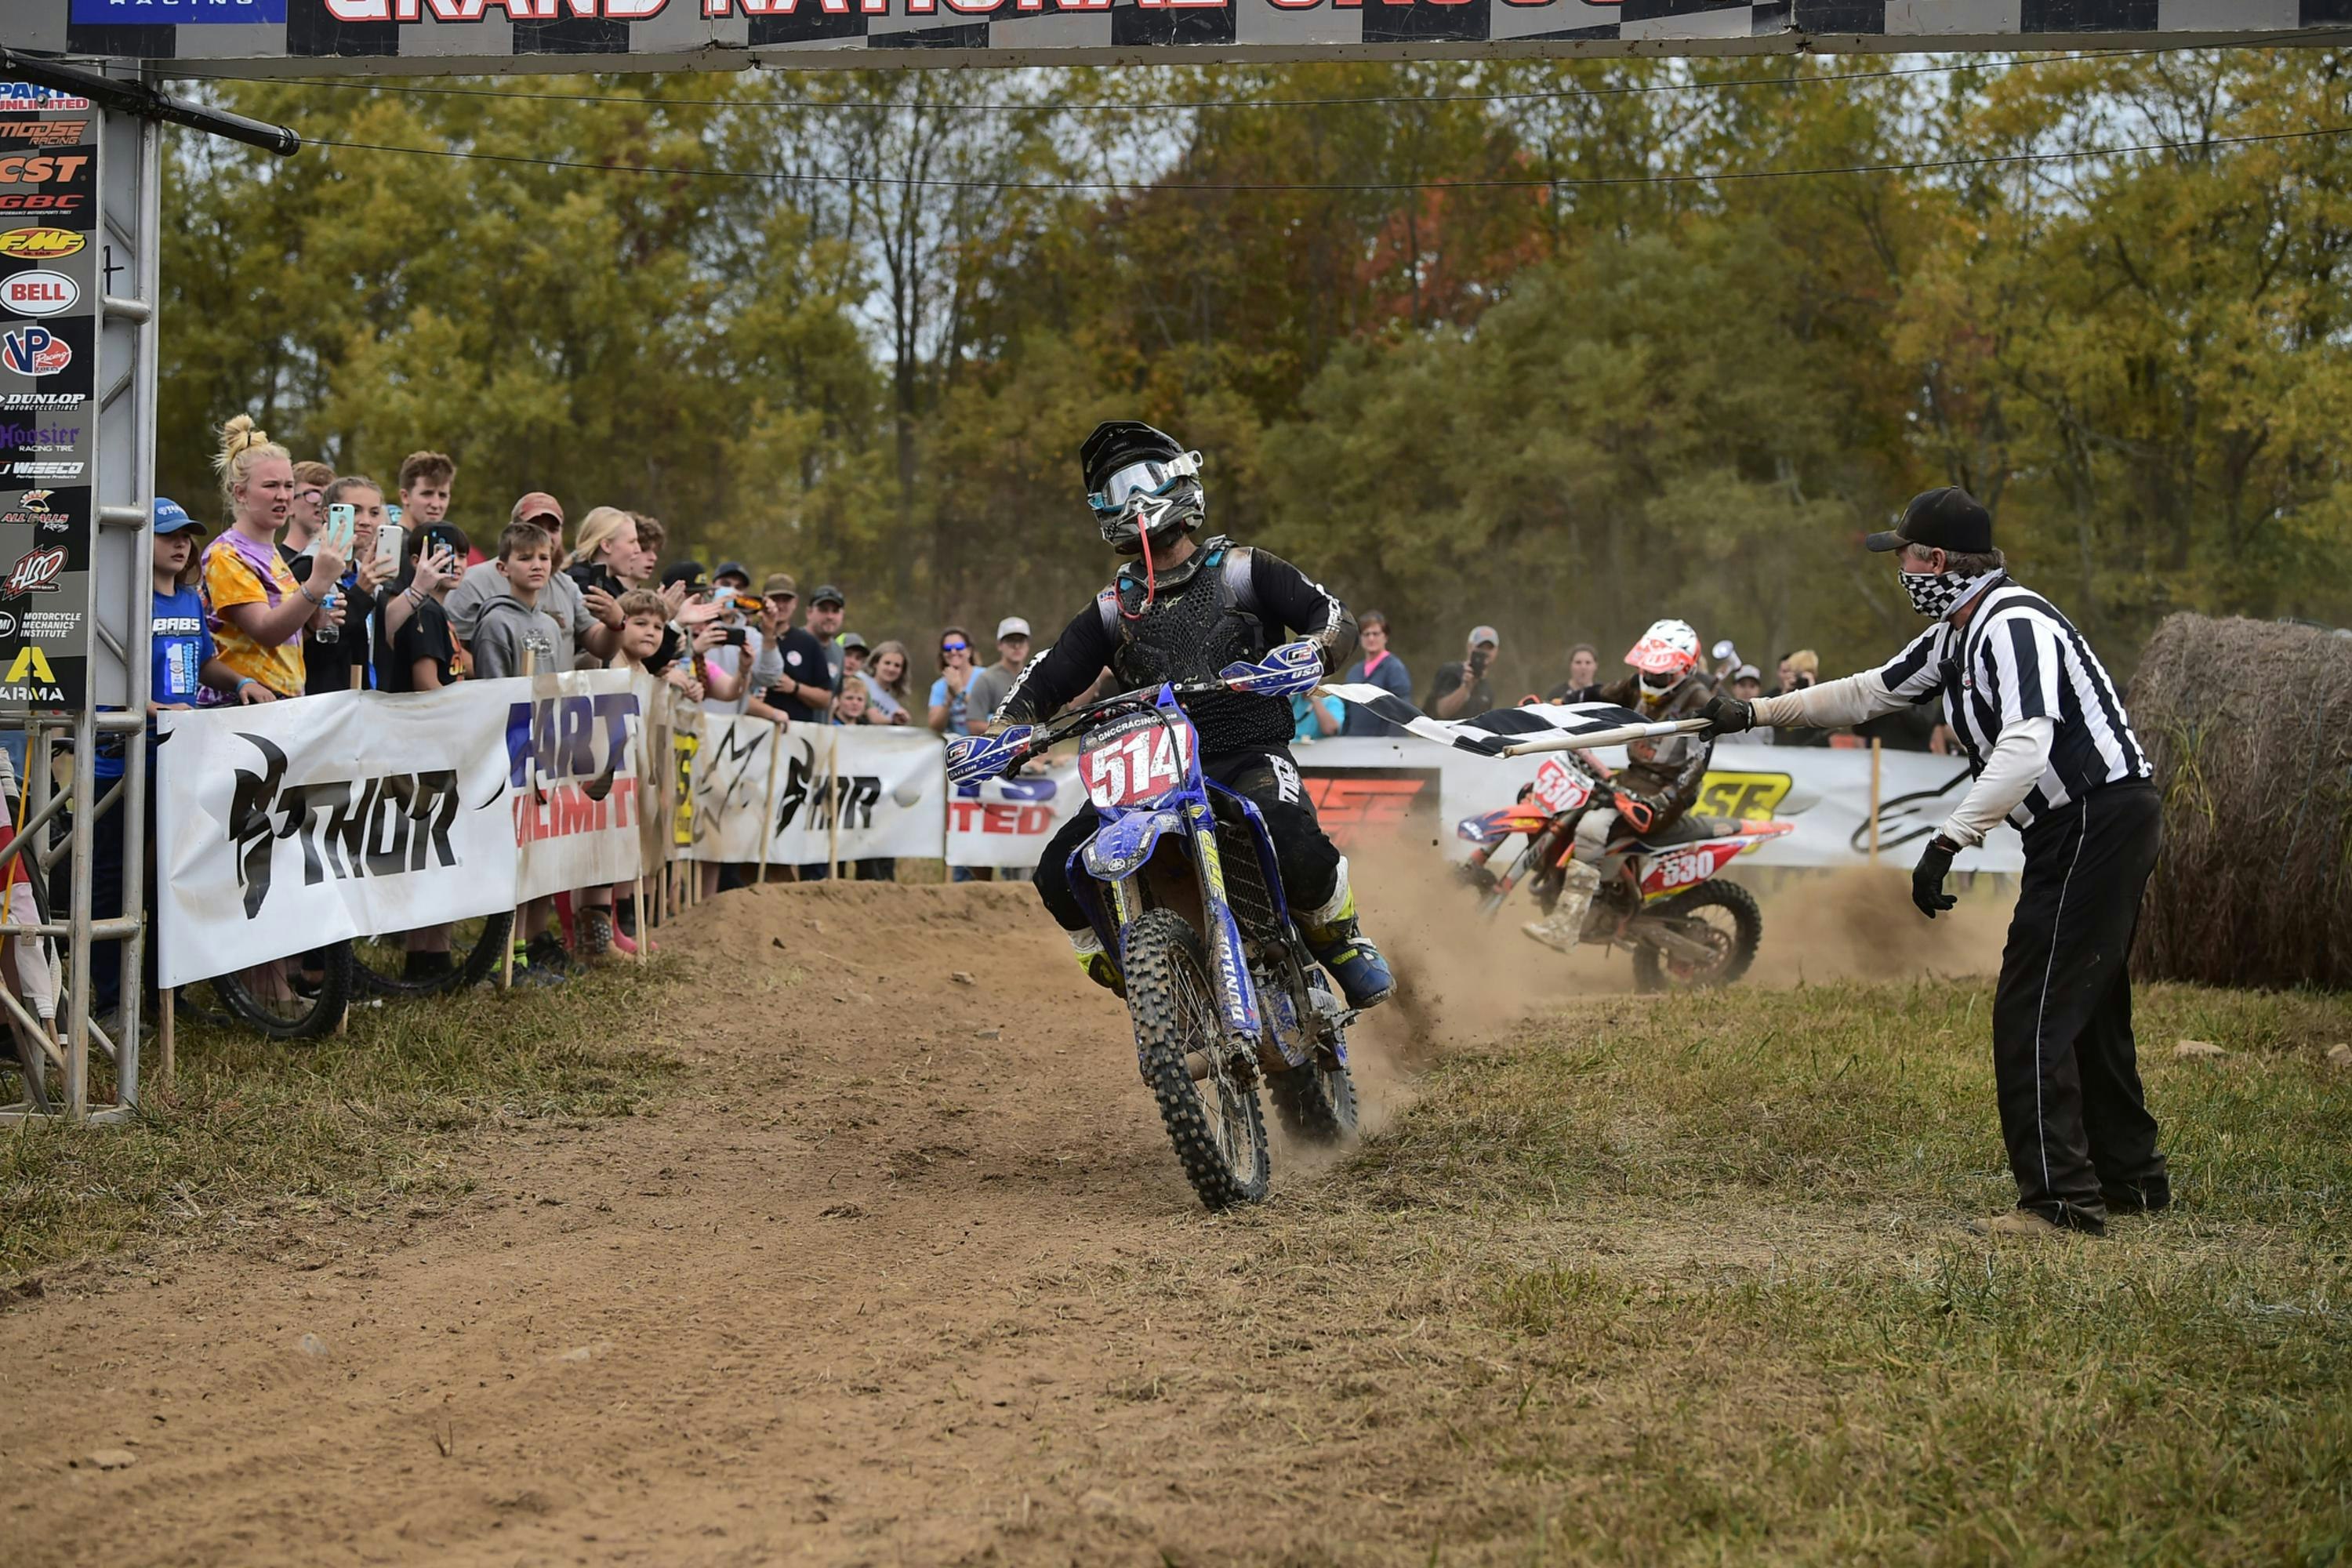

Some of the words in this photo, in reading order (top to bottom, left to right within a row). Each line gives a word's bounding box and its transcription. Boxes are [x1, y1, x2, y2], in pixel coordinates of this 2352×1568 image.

[0, 157, 88, 182] CST
[0, 195, 84, 208] GBC
[0, 231, 84, 250] FMF
[12, 284, 66, 300] BELL
[5, 326, 51, 373] VP
[6, 394, 85, 404] DUNLOP
[0, 421, 80, 448] Hoosier
[2, 514, 26, 522] ALL
[24, 612, 82, 621] MOTORCYCLE
[1291, 666, 1320, 679] USA
[1098, 713, 1178, 742] GNCCRACING.OM
[1091, 724, 1189, 808] 514
[1533, 767, 1584, 814] 530
[276, 768, 460, 887] THOR
[1663, 851, 1715, 887] 530
